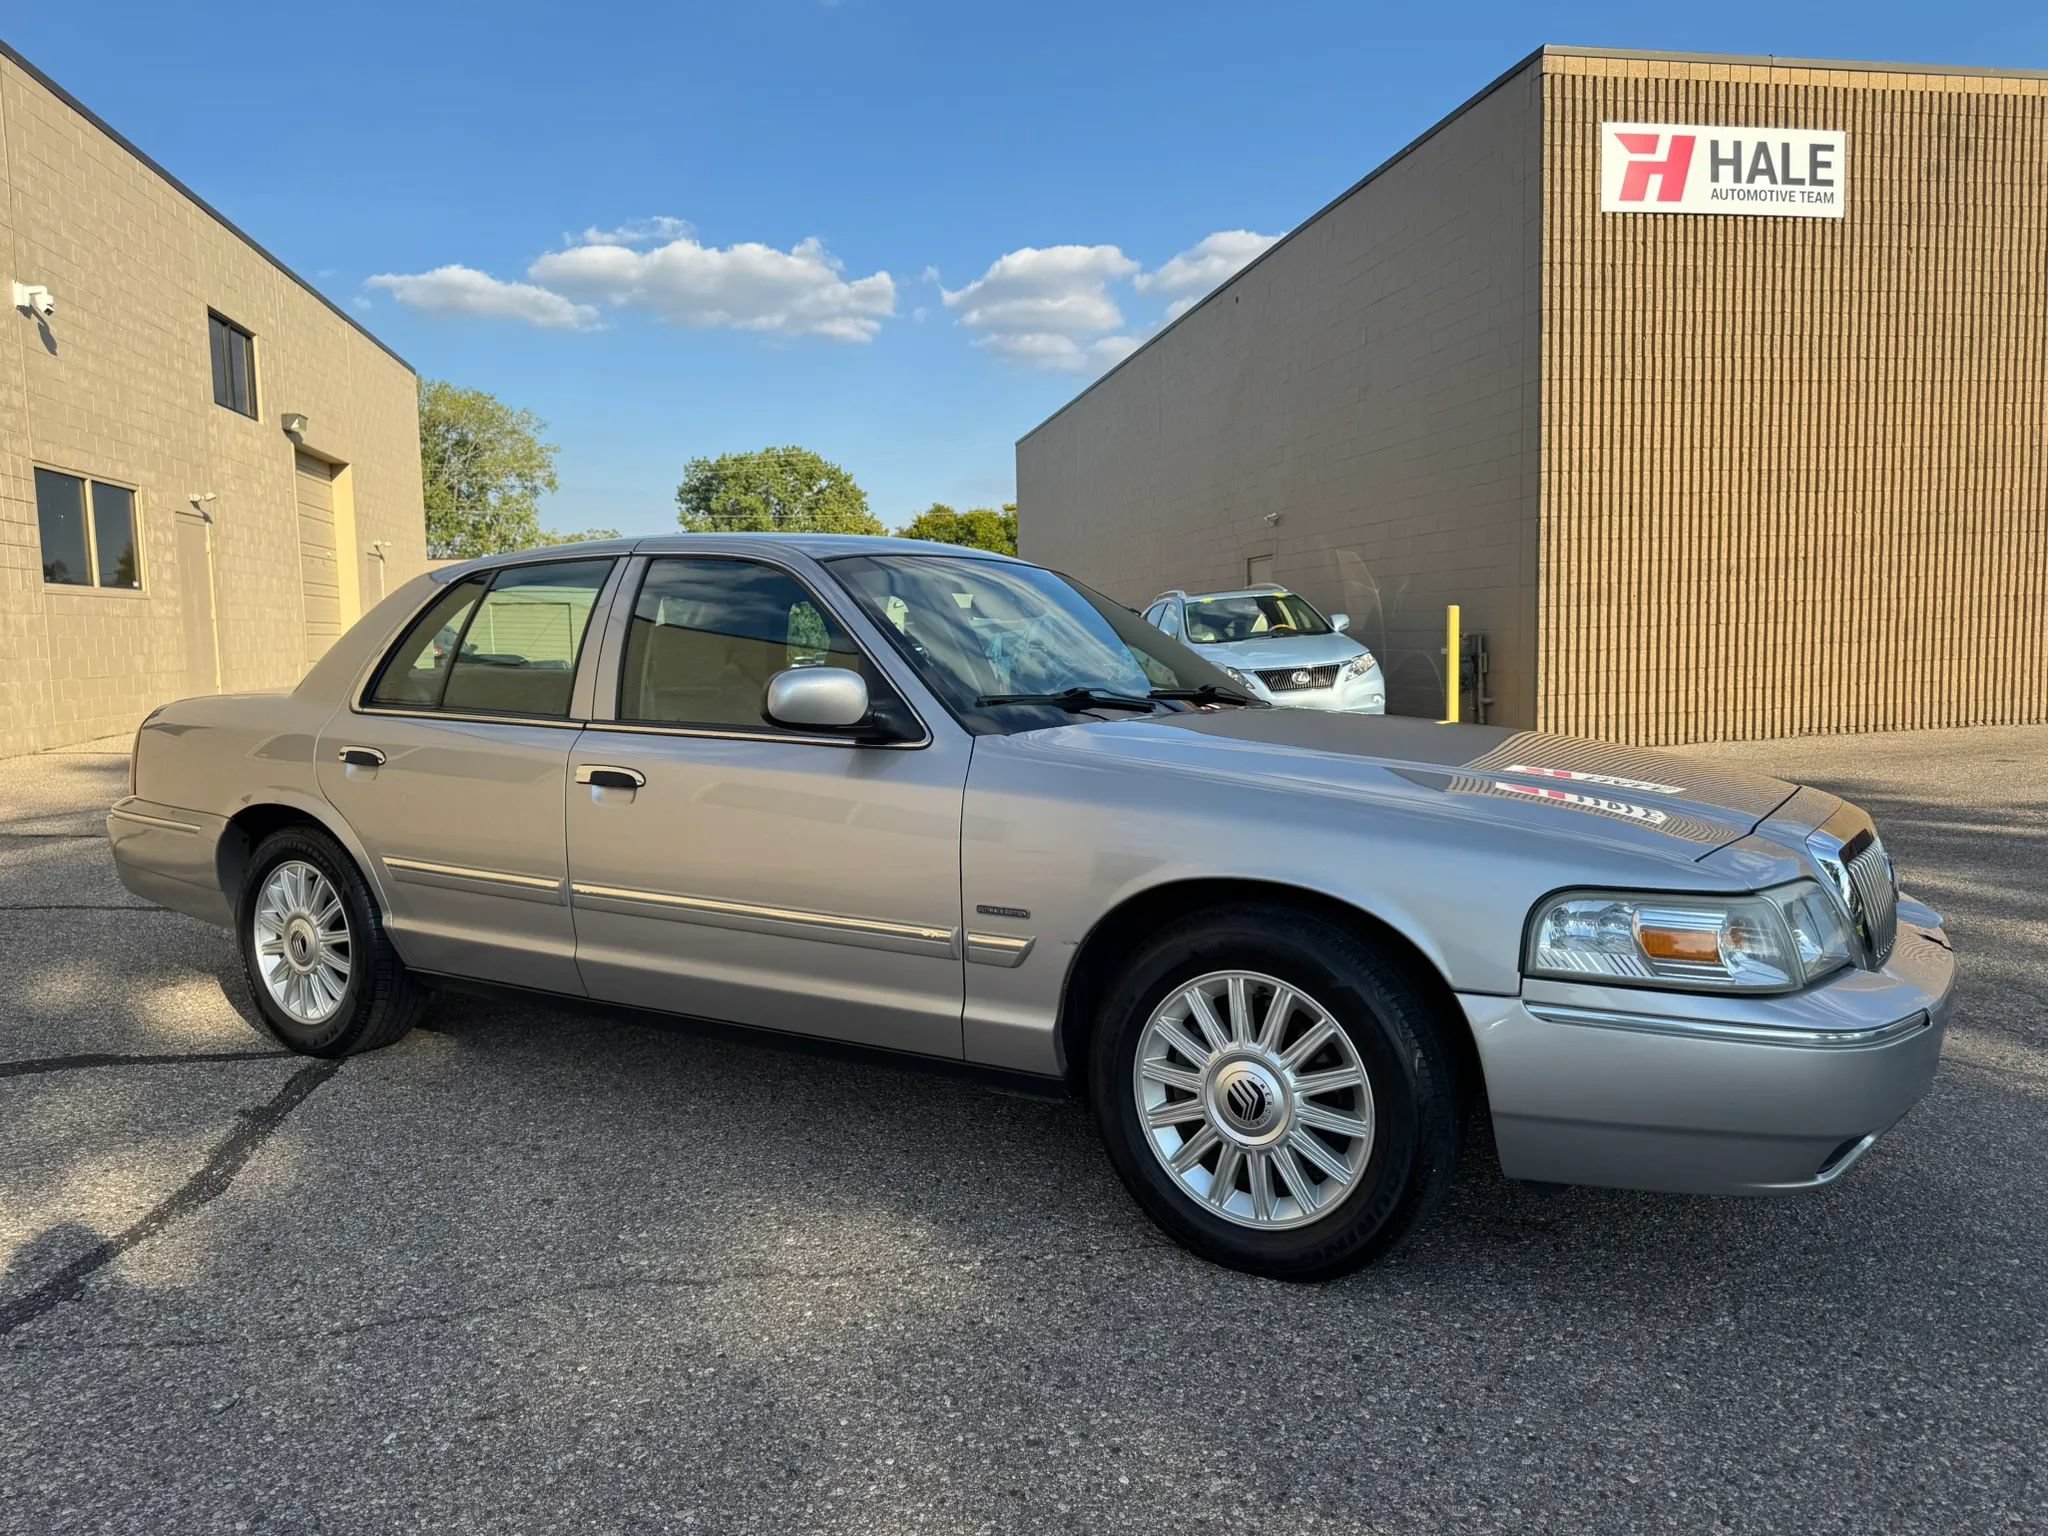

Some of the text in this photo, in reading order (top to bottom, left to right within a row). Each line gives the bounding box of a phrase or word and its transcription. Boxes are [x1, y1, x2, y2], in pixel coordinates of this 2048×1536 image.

[1710, 139, 1834, 187] HALE
[1710, 188, 1834, 204] AUTOMOTIVE TEAM
[1249, 1083, 1272, 1127] MERCURY
